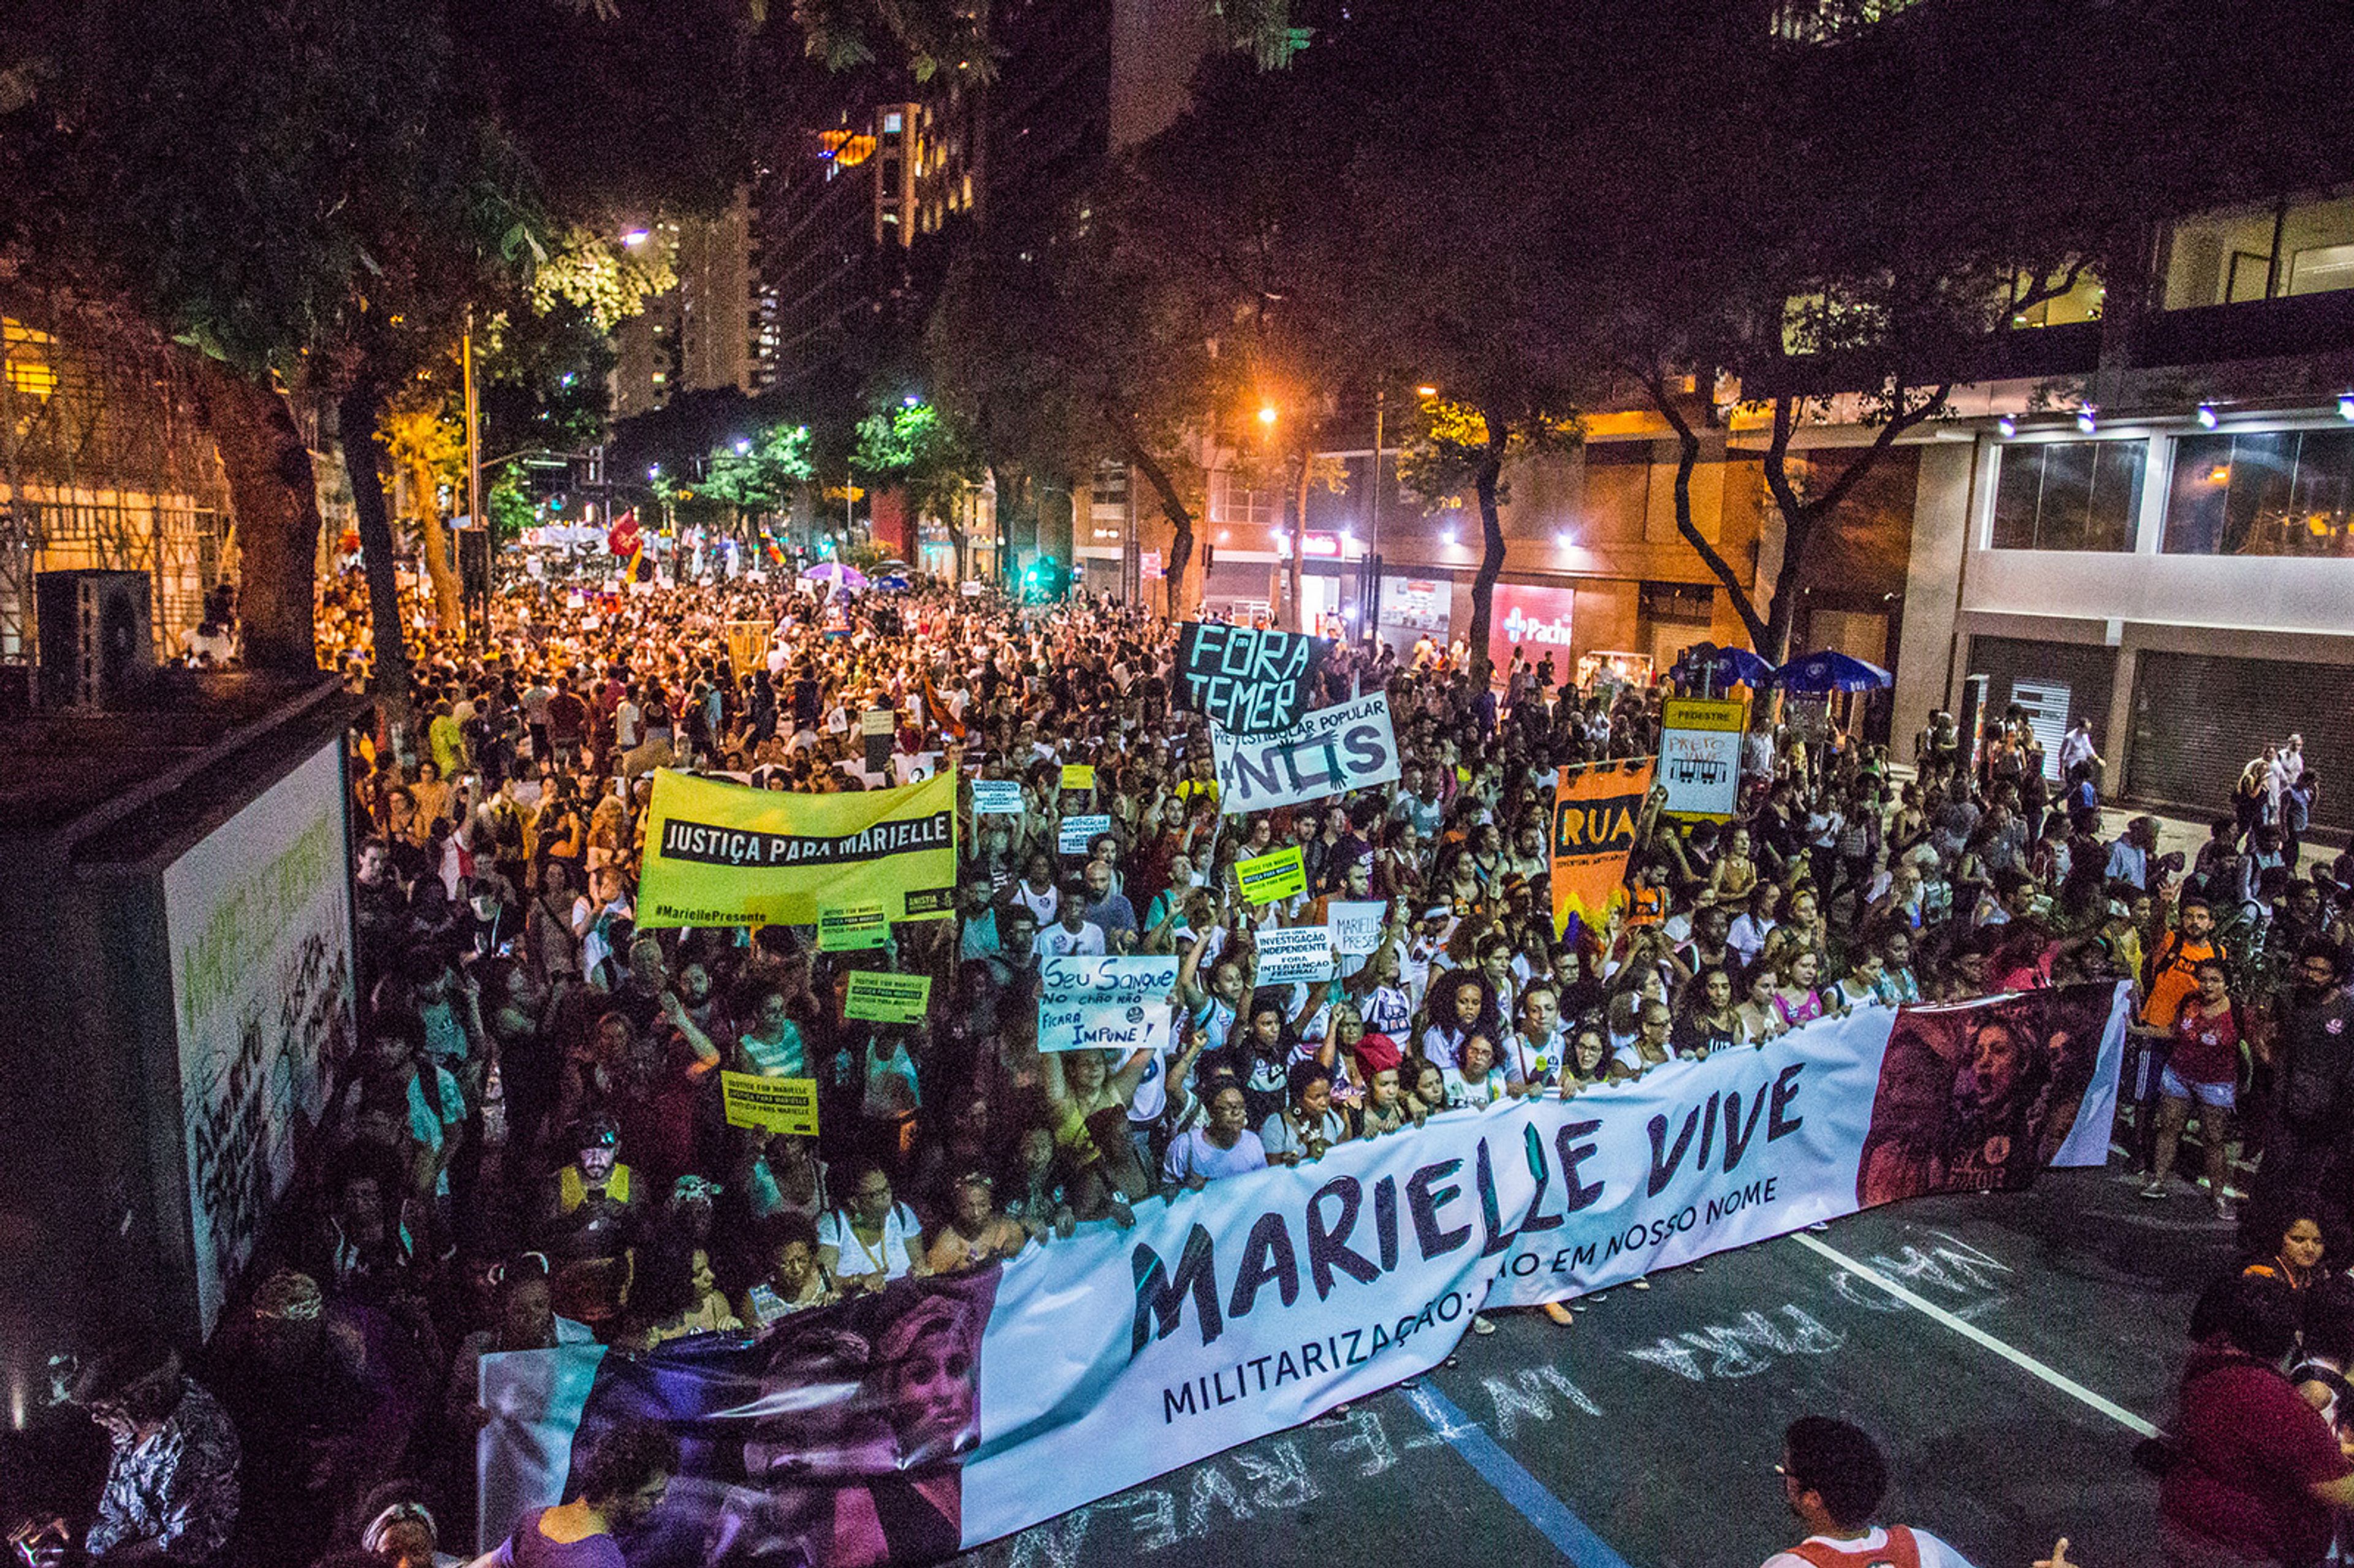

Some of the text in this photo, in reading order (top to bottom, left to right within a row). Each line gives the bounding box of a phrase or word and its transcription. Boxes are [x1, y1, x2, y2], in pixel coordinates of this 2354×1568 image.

[1190, 625, 1309, 680] FORA
[1186, 673, 1295, 732] TEMER
[1319, 700, 1385, 731] POPULAR
[1678, 710, 1730, 721] PEDESTRE
[666, 816, 947, 864] JUSTIÇA PARA MARIELLE
[1563, 807, 1635, 846] RUA
[656, 904, 766, 923] #MariellePresente
[1338, 915, 1382, 935] MARIELLE
[1260, 932, 1326, 945] INVESTIGAÇÃO
[1260, 943, 1327, 954] INDEPENDENTE
[1096, 957, 1174, 994] Sangue
[1261, 960, 1329, 972] INTERVENÇÃO
[1117, 992, 1141, 1004] NÃO
[1130, 1062, 1807, 1351] MARIELLE VIVE
[1163, 1284, 1474, 1426] MILITARIZAÇÃO:
[1551, 1242, 1596, 1274] EM
[1604, 1206, 1697, 1260] NOSSO
[1705, 1177, 1777, 1225] NOME
